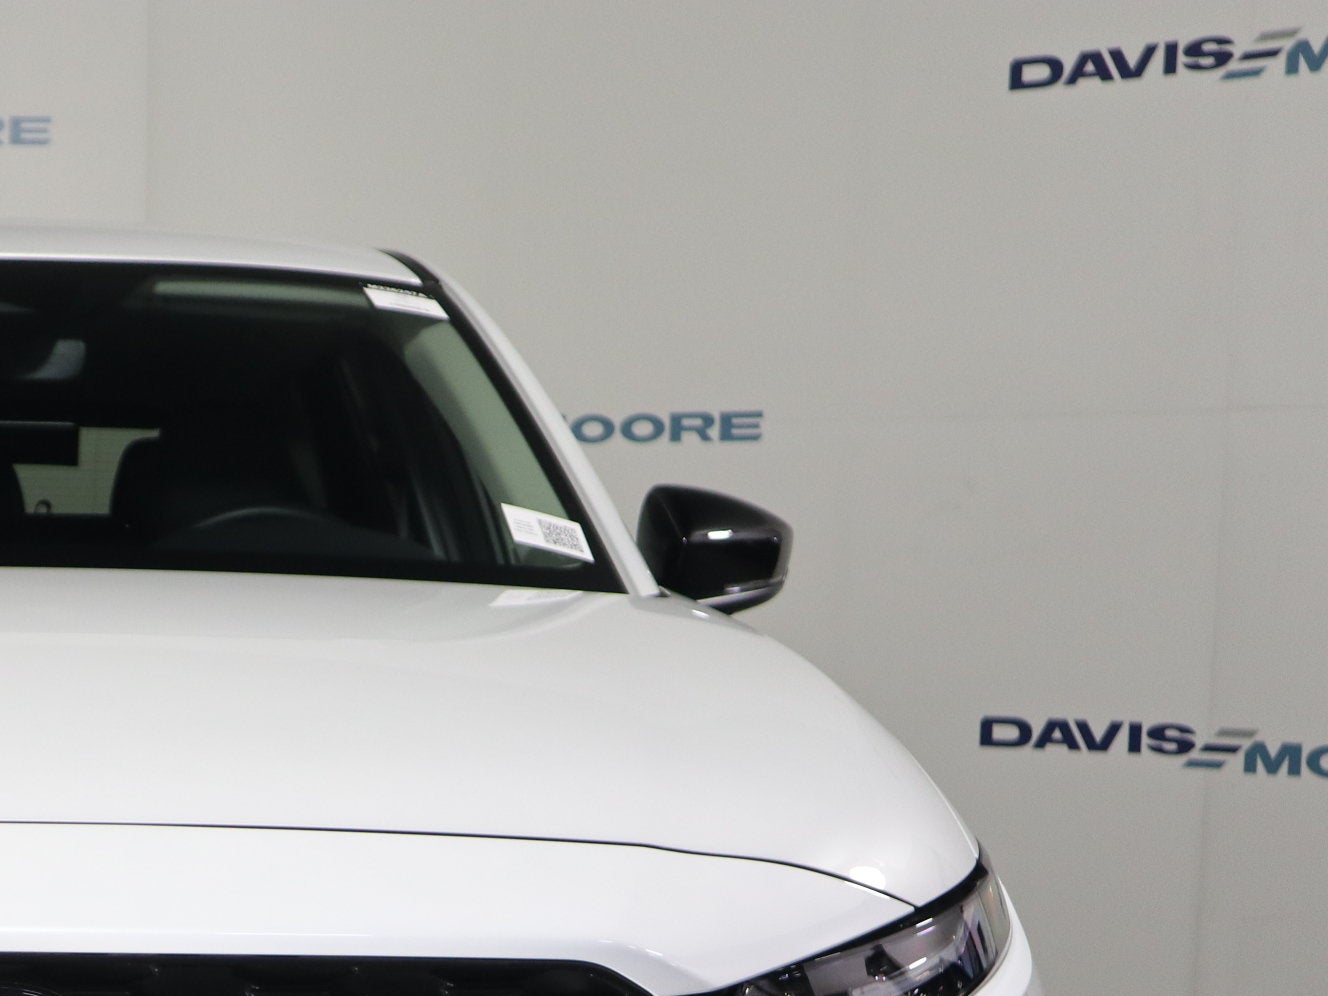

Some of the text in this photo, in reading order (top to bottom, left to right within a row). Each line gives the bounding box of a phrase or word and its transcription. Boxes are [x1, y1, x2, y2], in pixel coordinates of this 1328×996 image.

[1008, 35, 1235, 91] DAVIS
[561, 410, 764, 443] OORE
[978, 714, 1197, 756] DAVIS
